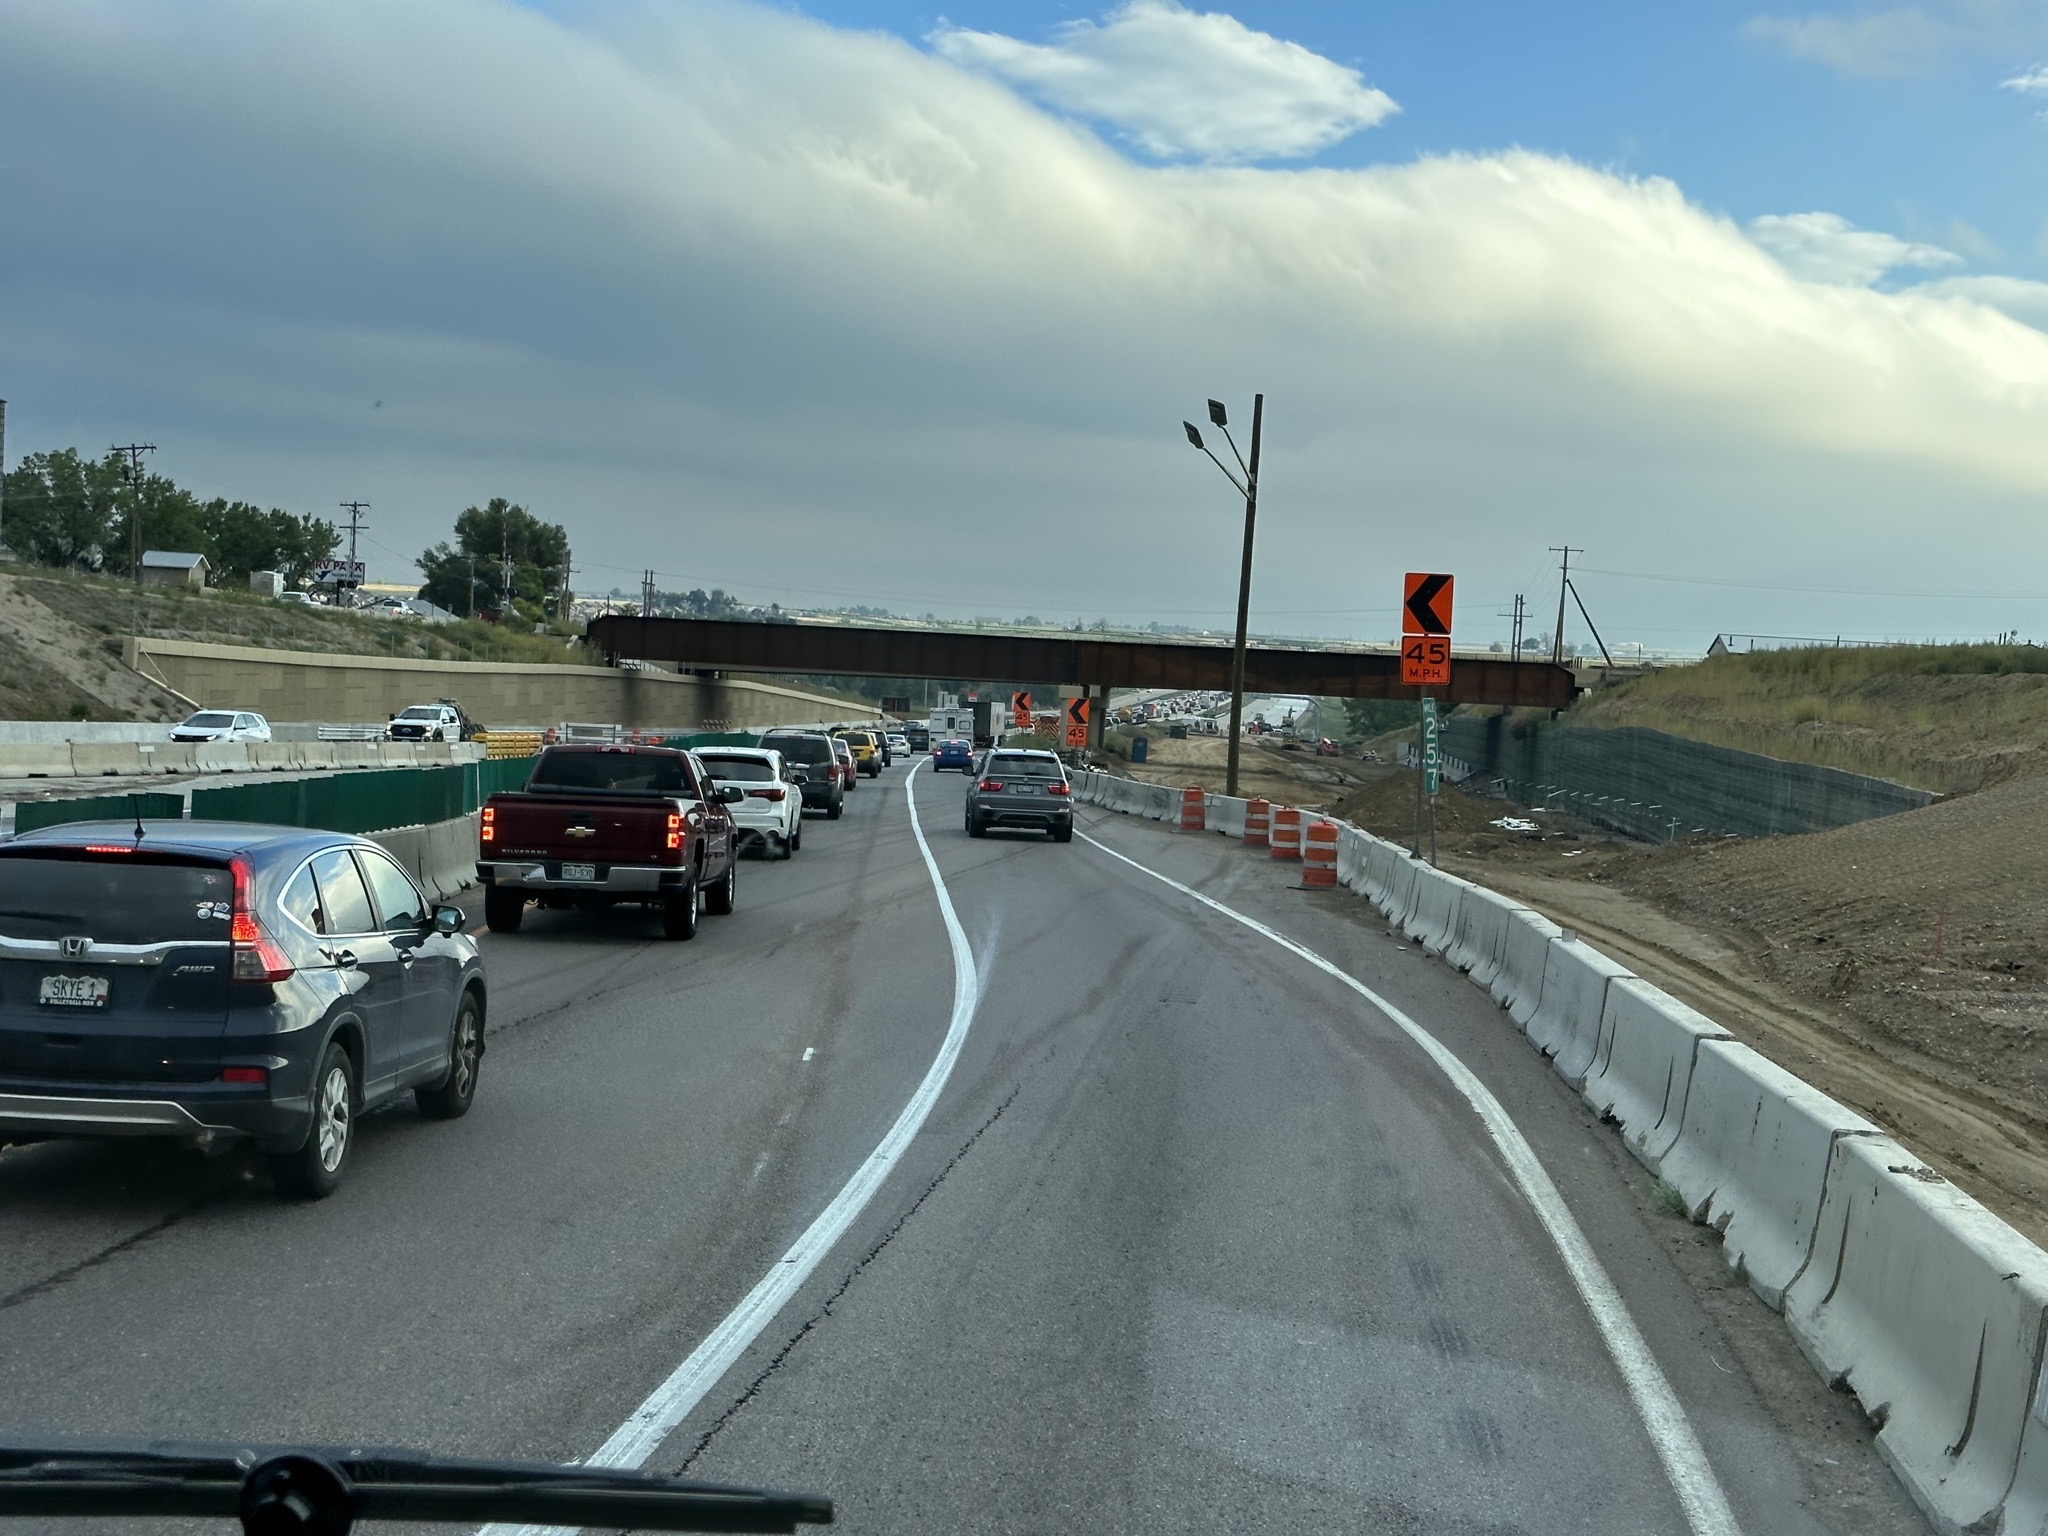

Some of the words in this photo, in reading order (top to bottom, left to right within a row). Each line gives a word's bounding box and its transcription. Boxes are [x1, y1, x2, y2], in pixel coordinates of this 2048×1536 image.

[315, 560, 330, 570] RV
[333, 560, 362, 572] PAK
[1405, 643, 1446, 665] 45
[1016, 713, 1029, 721] 45
[1068, 728, 1085, 739] 45
[1425, 717, 1437, 790] 257
[175, 965, 216, 974] AWD
[52, 979, 84, 998] SKYE
[88, 981, 96, 998] 1
